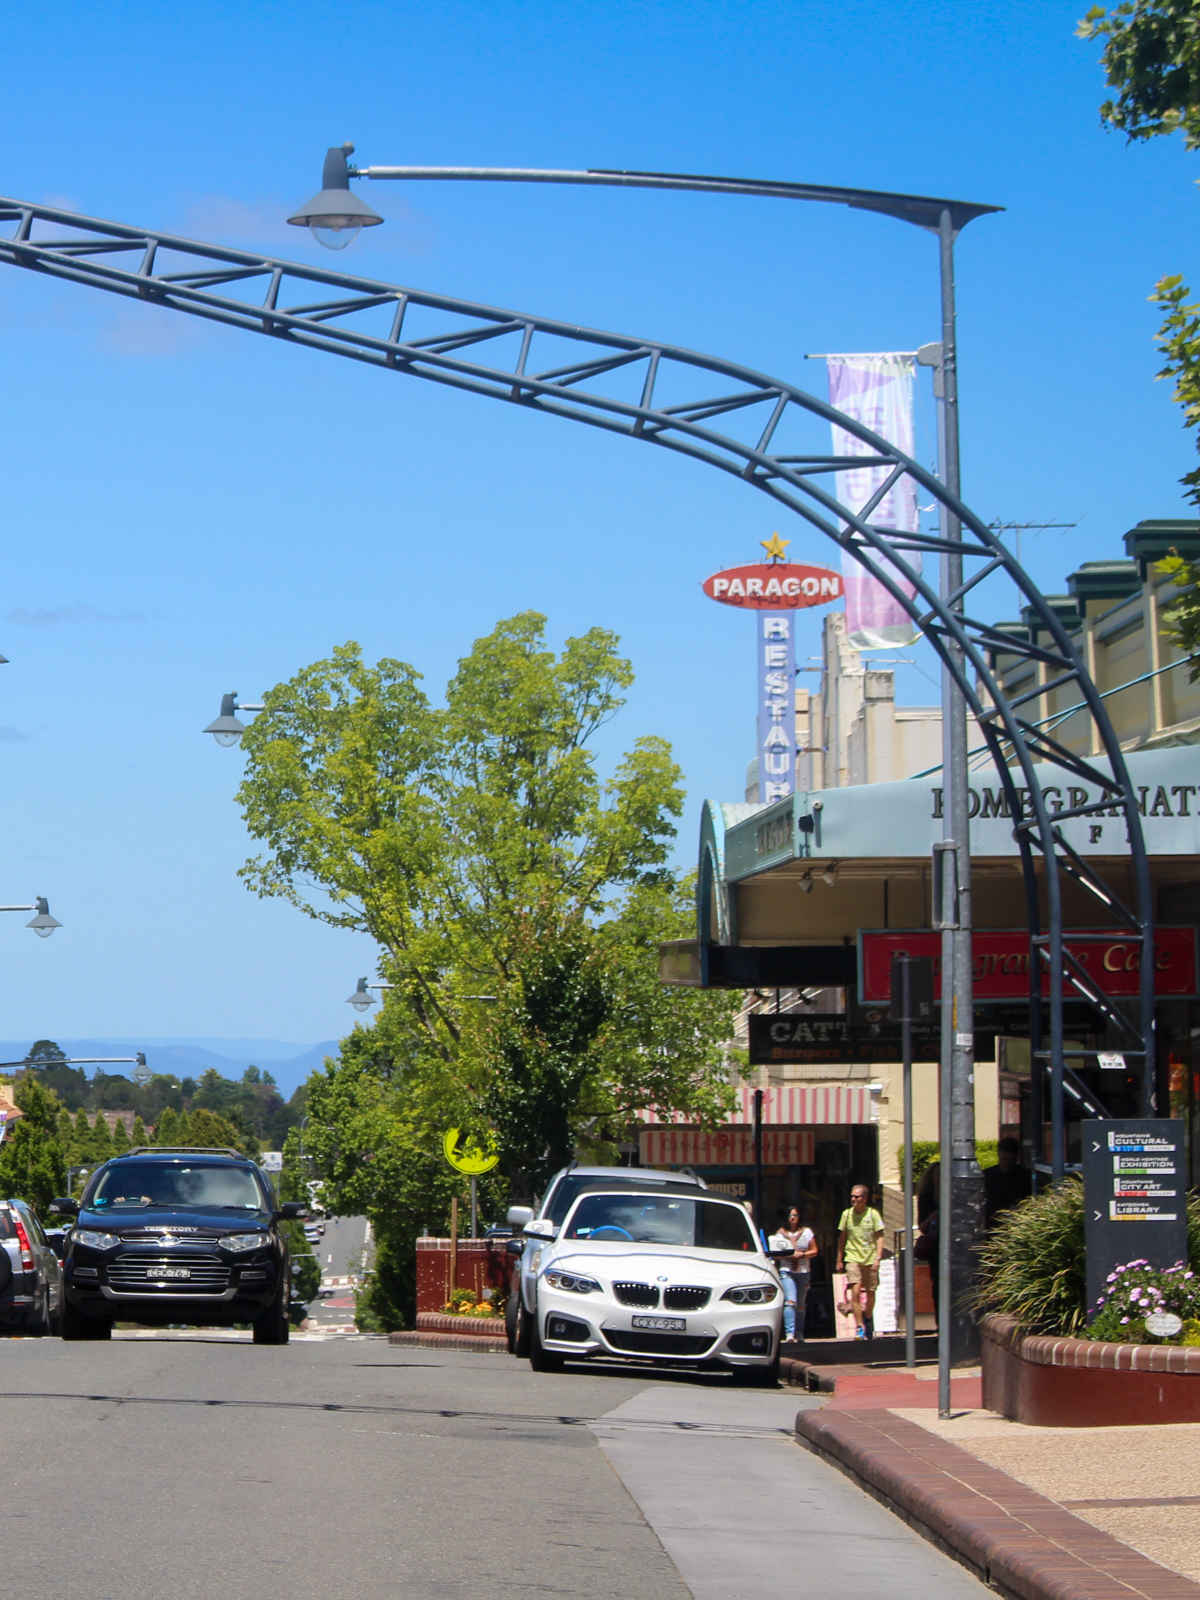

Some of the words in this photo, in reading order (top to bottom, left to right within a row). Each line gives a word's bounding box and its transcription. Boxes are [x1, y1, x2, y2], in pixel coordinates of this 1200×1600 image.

[713, 577, 840, 597] PARAGON
[931, 785, 1200, 819] OMEGRANAT
[1103, 943, 1173, 973] Cae
